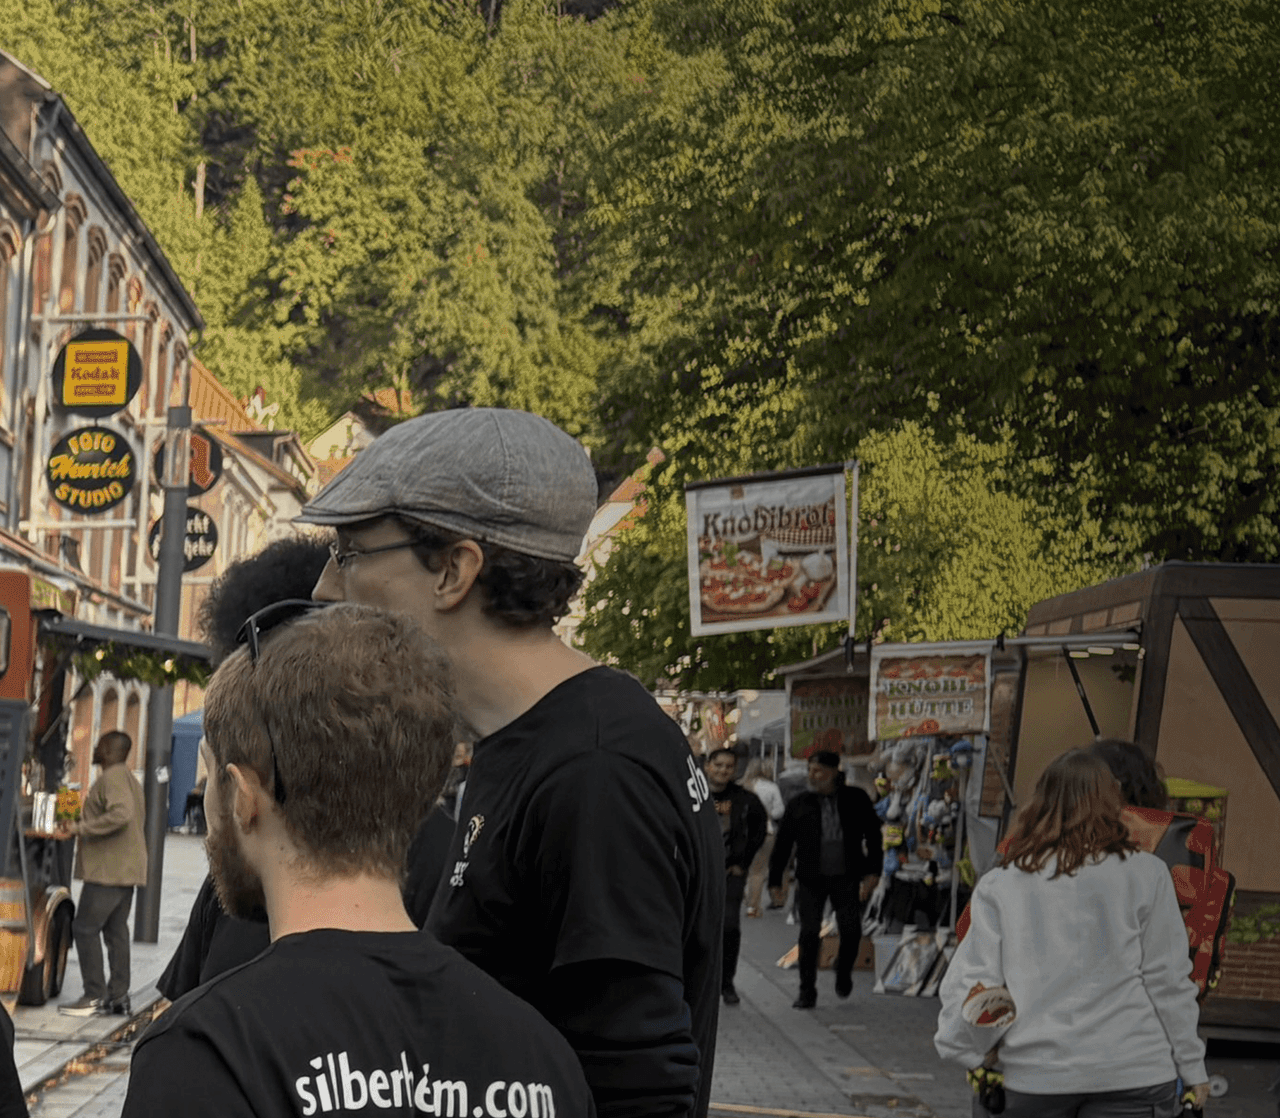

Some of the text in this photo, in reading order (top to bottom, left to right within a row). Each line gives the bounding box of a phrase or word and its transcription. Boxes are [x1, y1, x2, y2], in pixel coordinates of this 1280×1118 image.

[71, 366, 120, 381] Kodak
[68, 431, 116, 455] FOTO
[55, 481, 124, 508] STUDIO
